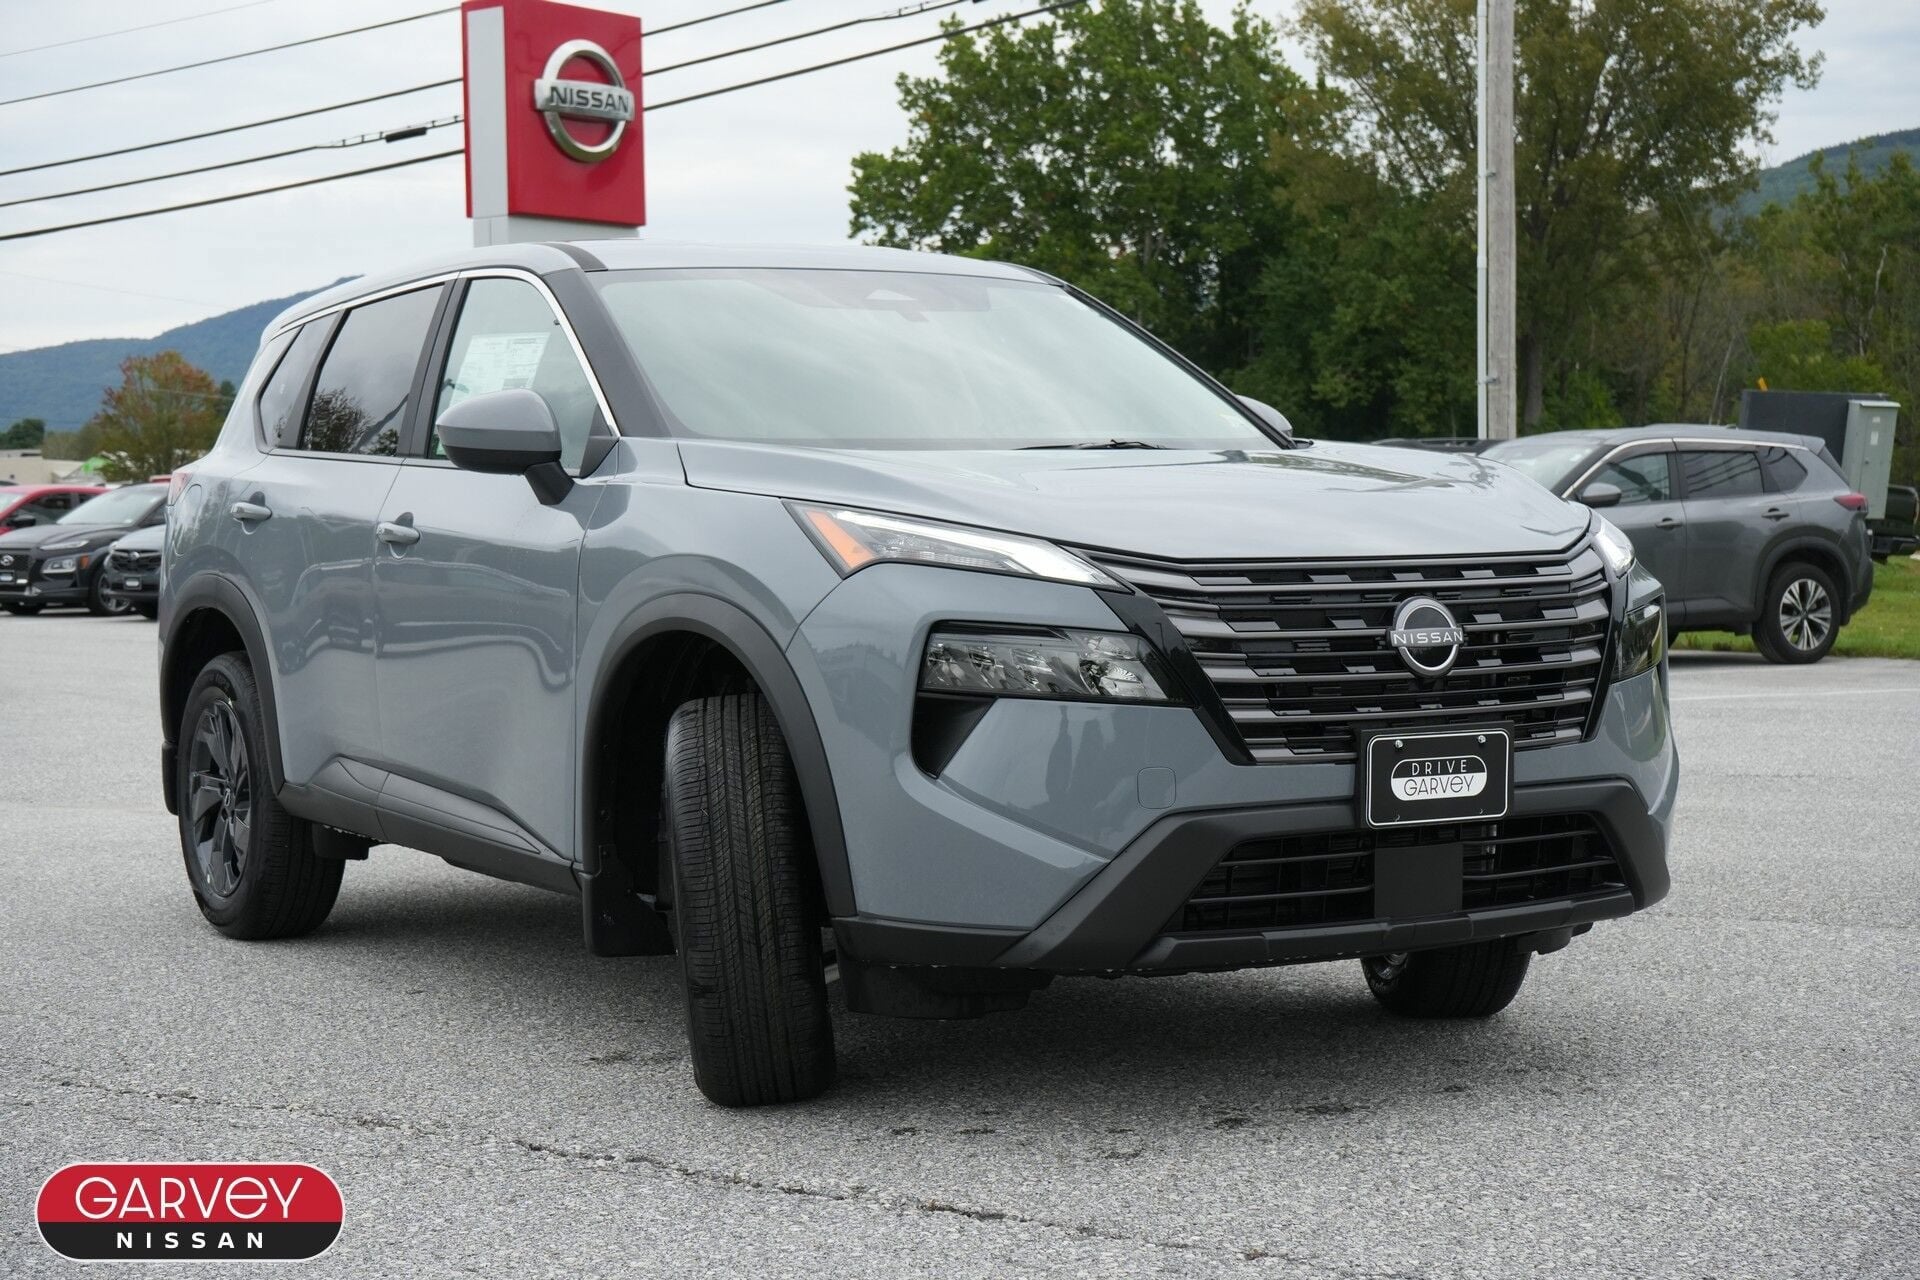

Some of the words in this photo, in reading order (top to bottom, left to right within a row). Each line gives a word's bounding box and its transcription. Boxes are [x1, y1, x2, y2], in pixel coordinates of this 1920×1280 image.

[550, 86, 630, 113] NISSAN
[1393, 631, 1463, 645] NISSAN
[1411, 759, 1468, 776] DRIVE
